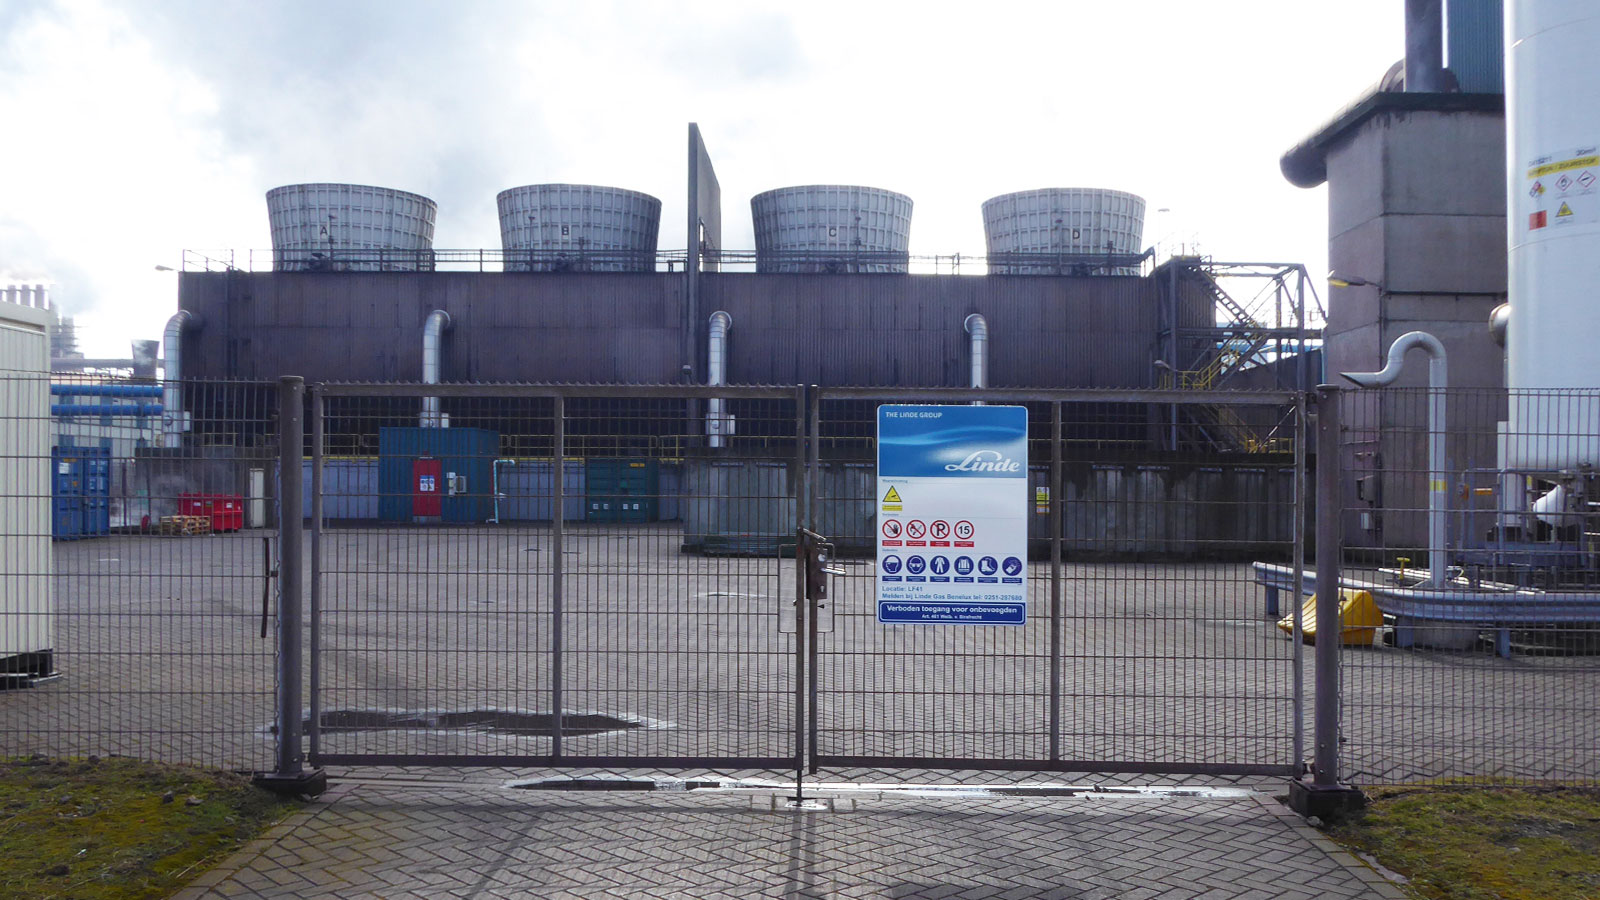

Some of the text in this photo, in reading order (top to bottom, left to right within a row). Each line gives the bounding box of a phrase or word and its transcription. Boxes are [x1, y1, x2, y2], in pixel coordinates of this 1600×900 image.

[320, 226, 328, 235] A
[562, 225, 569, 235] B
[829, 227, 837, 237] C
[1072, 230, 1080, 239] D
[944, 450, 1020, 472] Linde
[958, 526, 970, 535] 15
[969, 606, 1017, 614] onbevoegden
